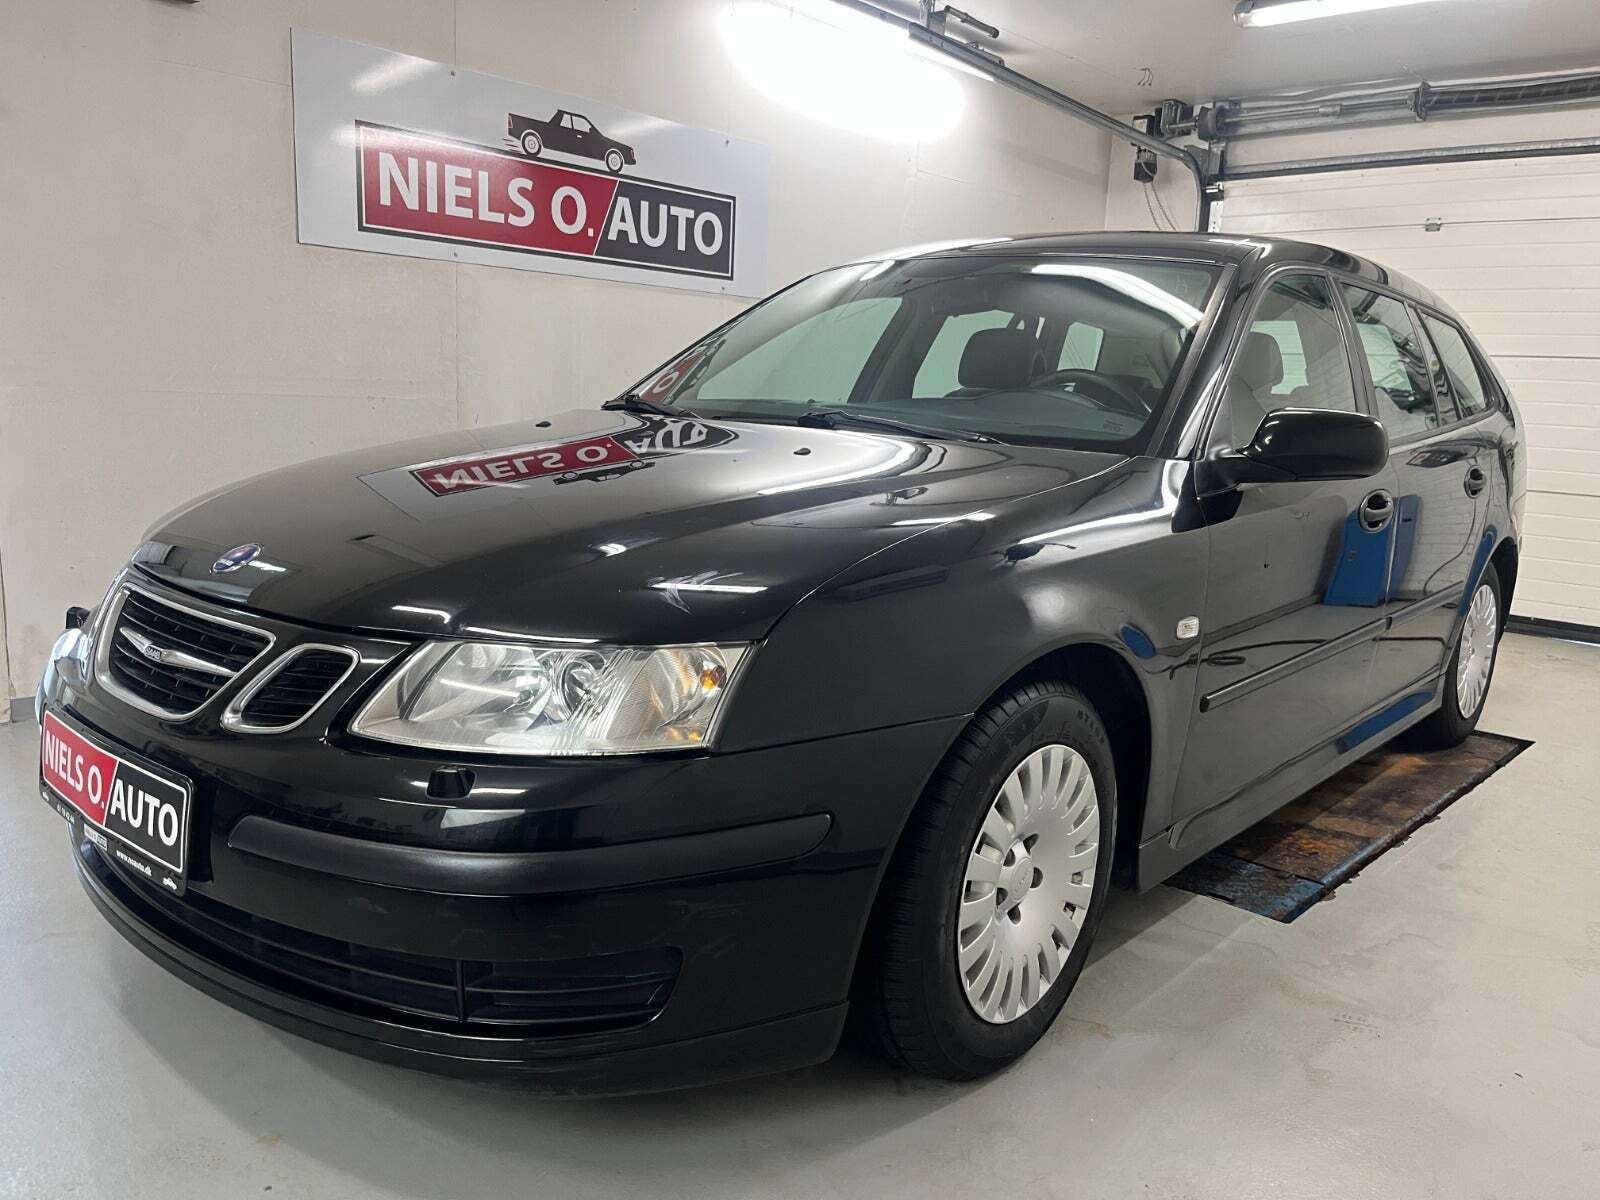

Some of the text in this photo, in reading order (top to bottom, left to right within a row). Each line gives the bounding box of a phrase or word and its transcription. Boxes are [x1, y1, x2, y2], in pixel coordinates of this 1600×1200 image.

[379, 151, 722, 255] NIELS O. AUTO
[45, 730, 83, 792] NIELS
[88, 765, 105, 809] O.
[110, 779, 178, 847] AUTO
